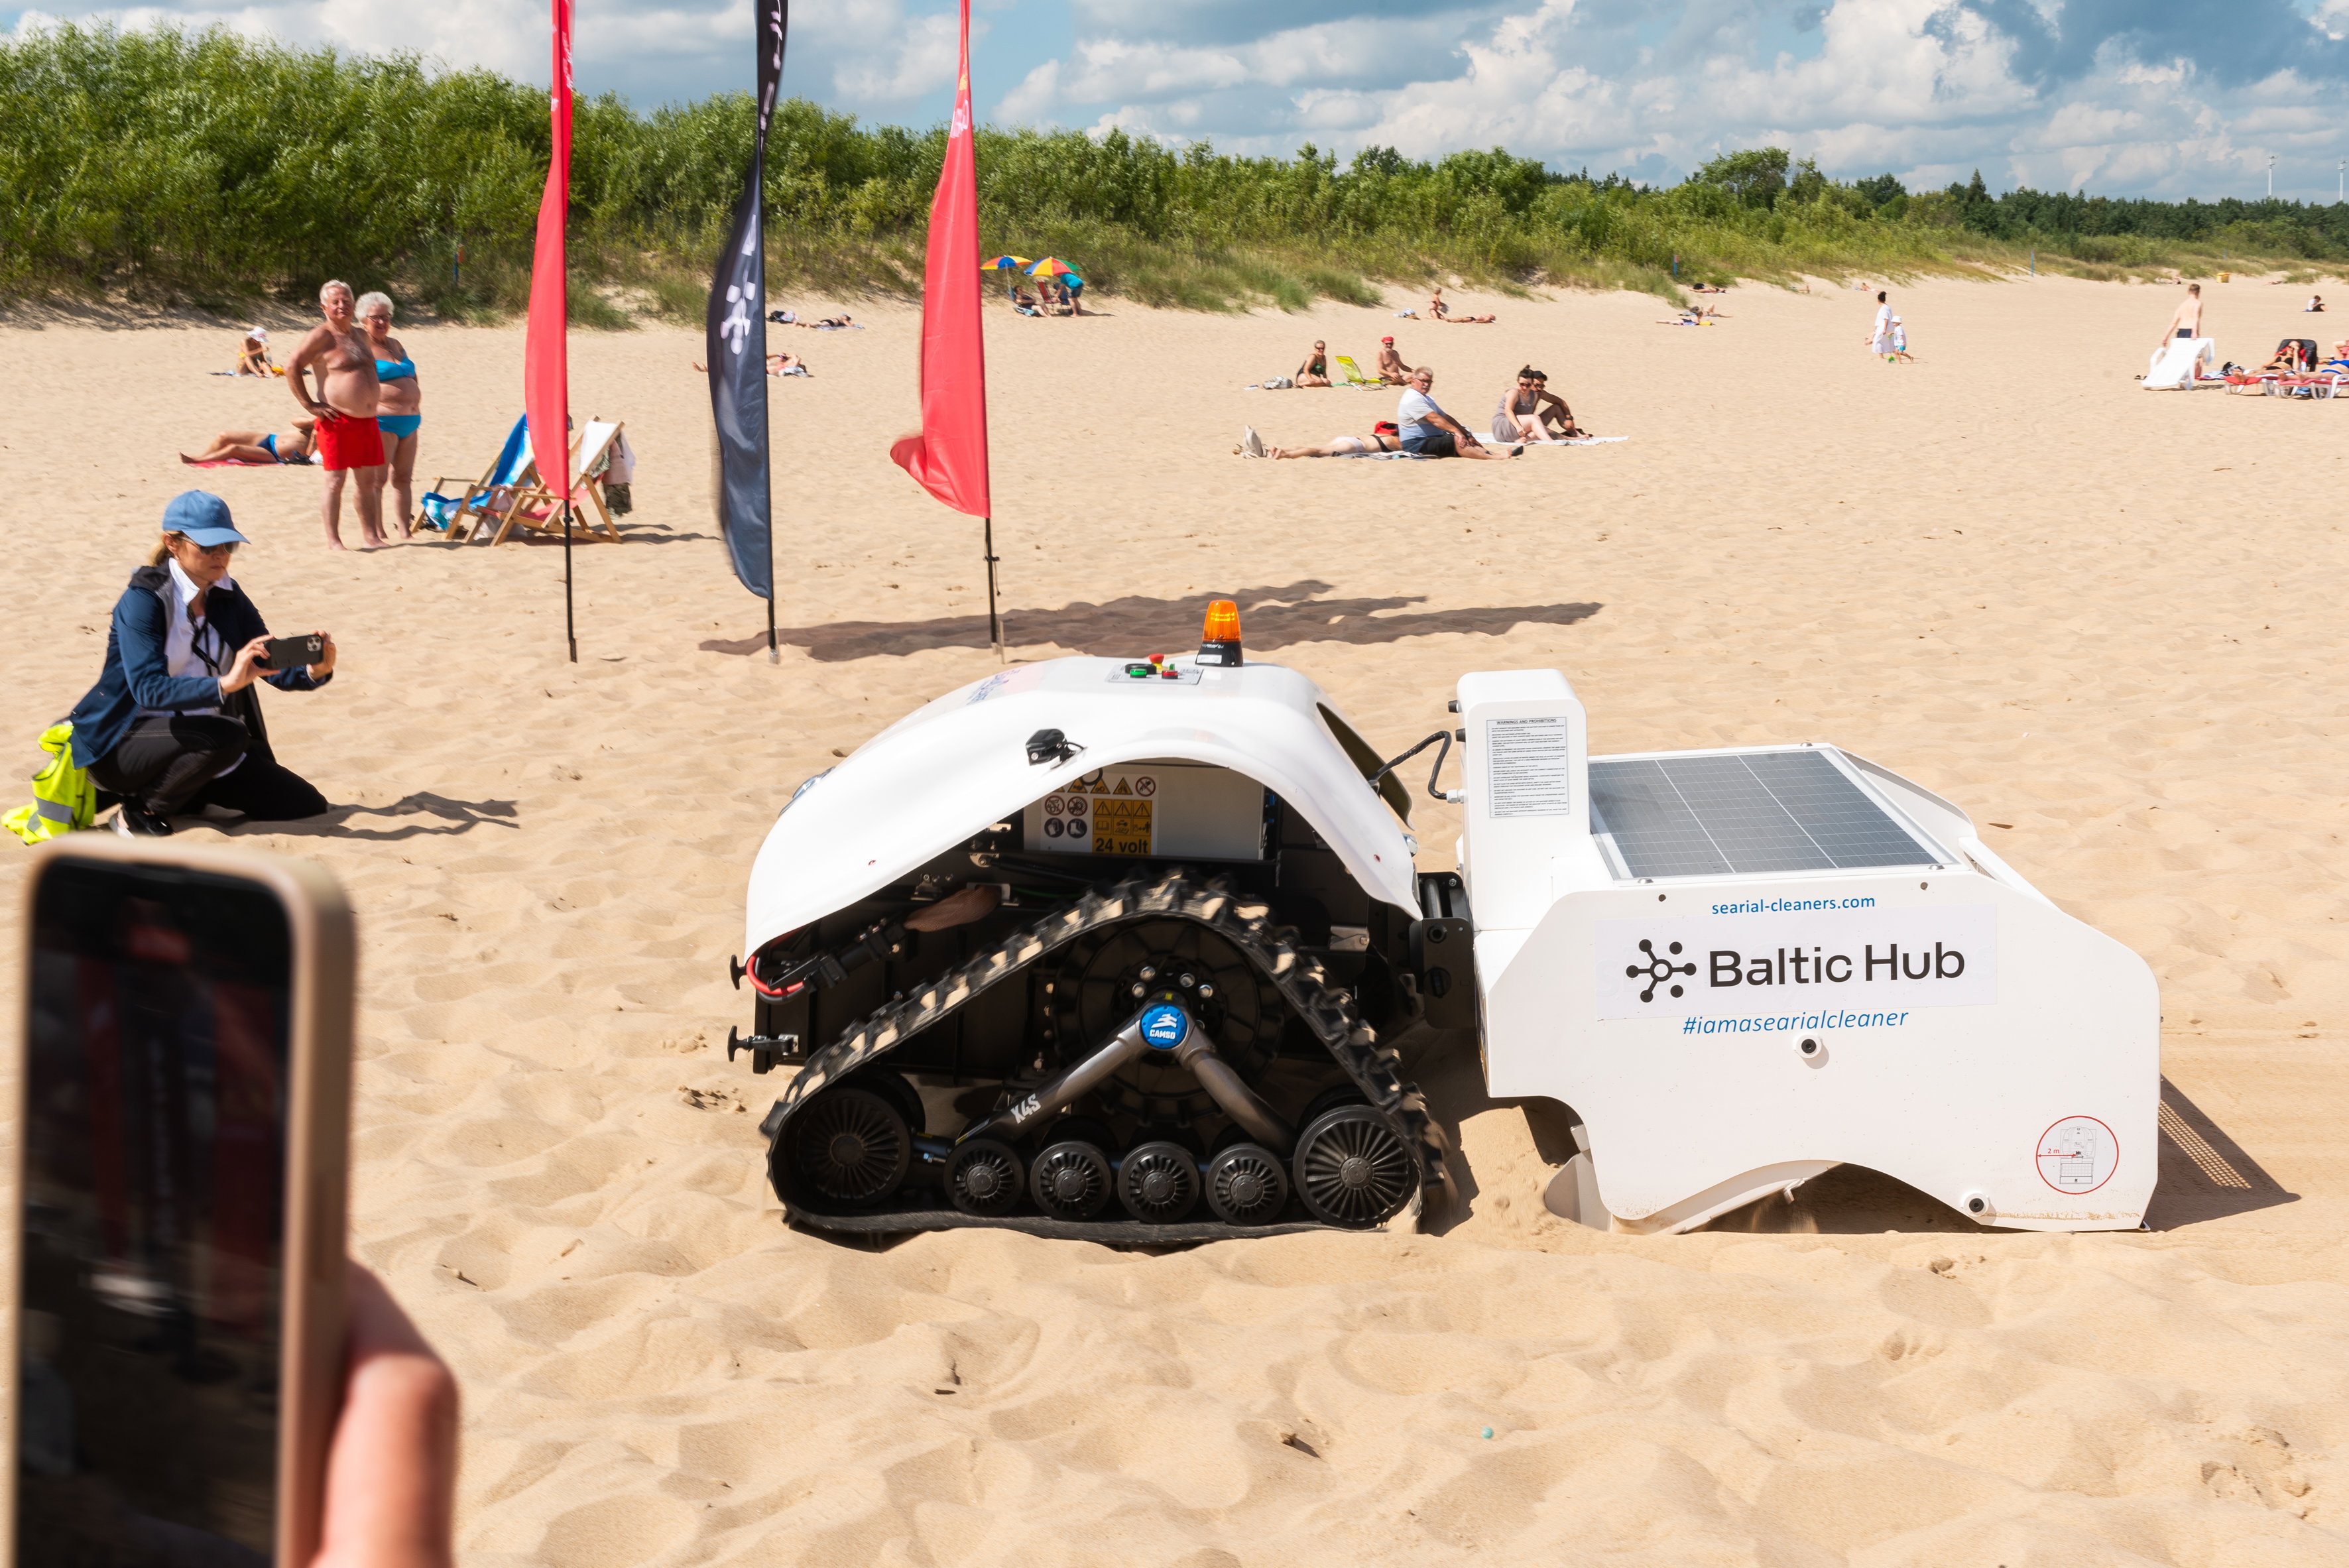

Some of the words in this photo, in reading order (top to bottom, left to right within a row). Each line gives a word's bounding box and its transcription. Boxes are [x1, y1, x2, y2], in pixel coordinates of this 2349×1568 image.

[1095, 837, 1114, 852] 24
[1118, 838, 1148, 854] volt
[1712, 897, 1875, 914] searial-cleaners.com
[1709, 946, 1852, 988] Baltic
[1865, 941, 1965, 981] Hub
[1683, 1010, 1909, 1034] #iamasearialcleaner
[1149, 1029, 1176, 1040] CAMSO
